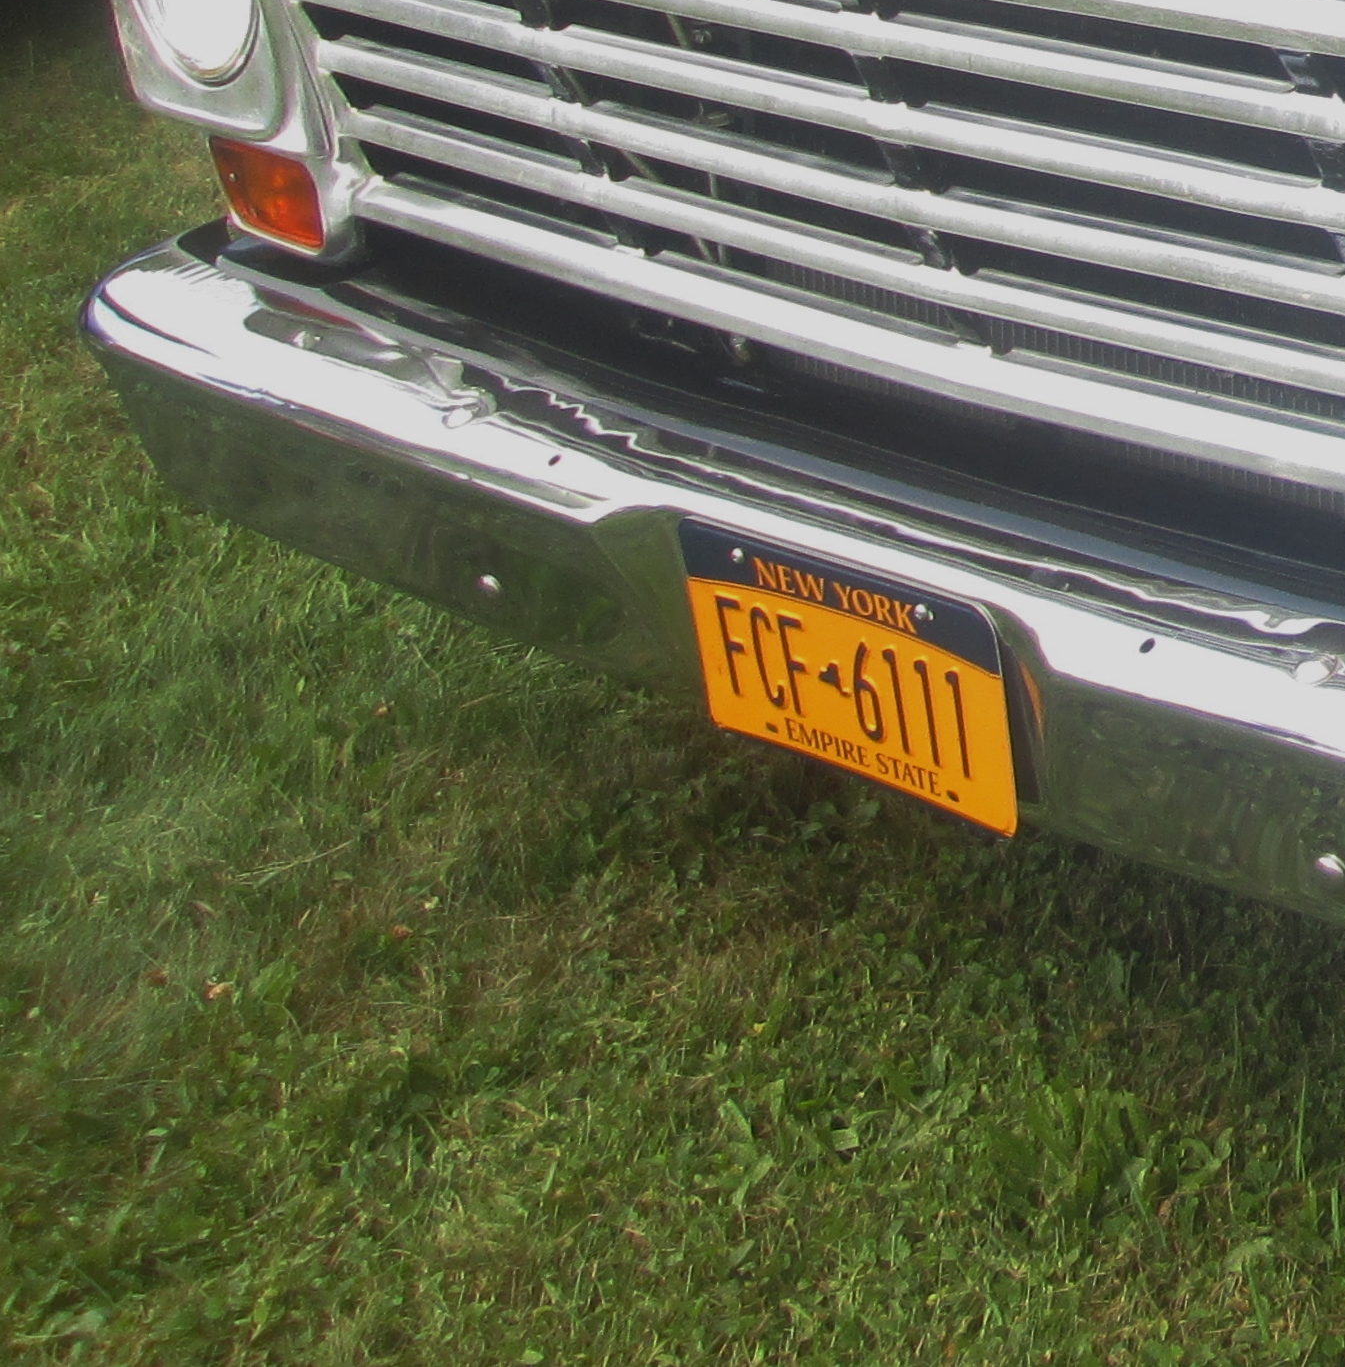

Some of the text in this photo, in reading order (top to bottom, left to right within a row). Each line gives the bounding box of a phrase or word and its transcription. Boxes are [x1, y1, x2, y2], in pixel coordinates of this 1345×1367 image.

[752, 558, 917, 634] NEW YORK
[784, 716, 942, 797] EMPIRE STATE
